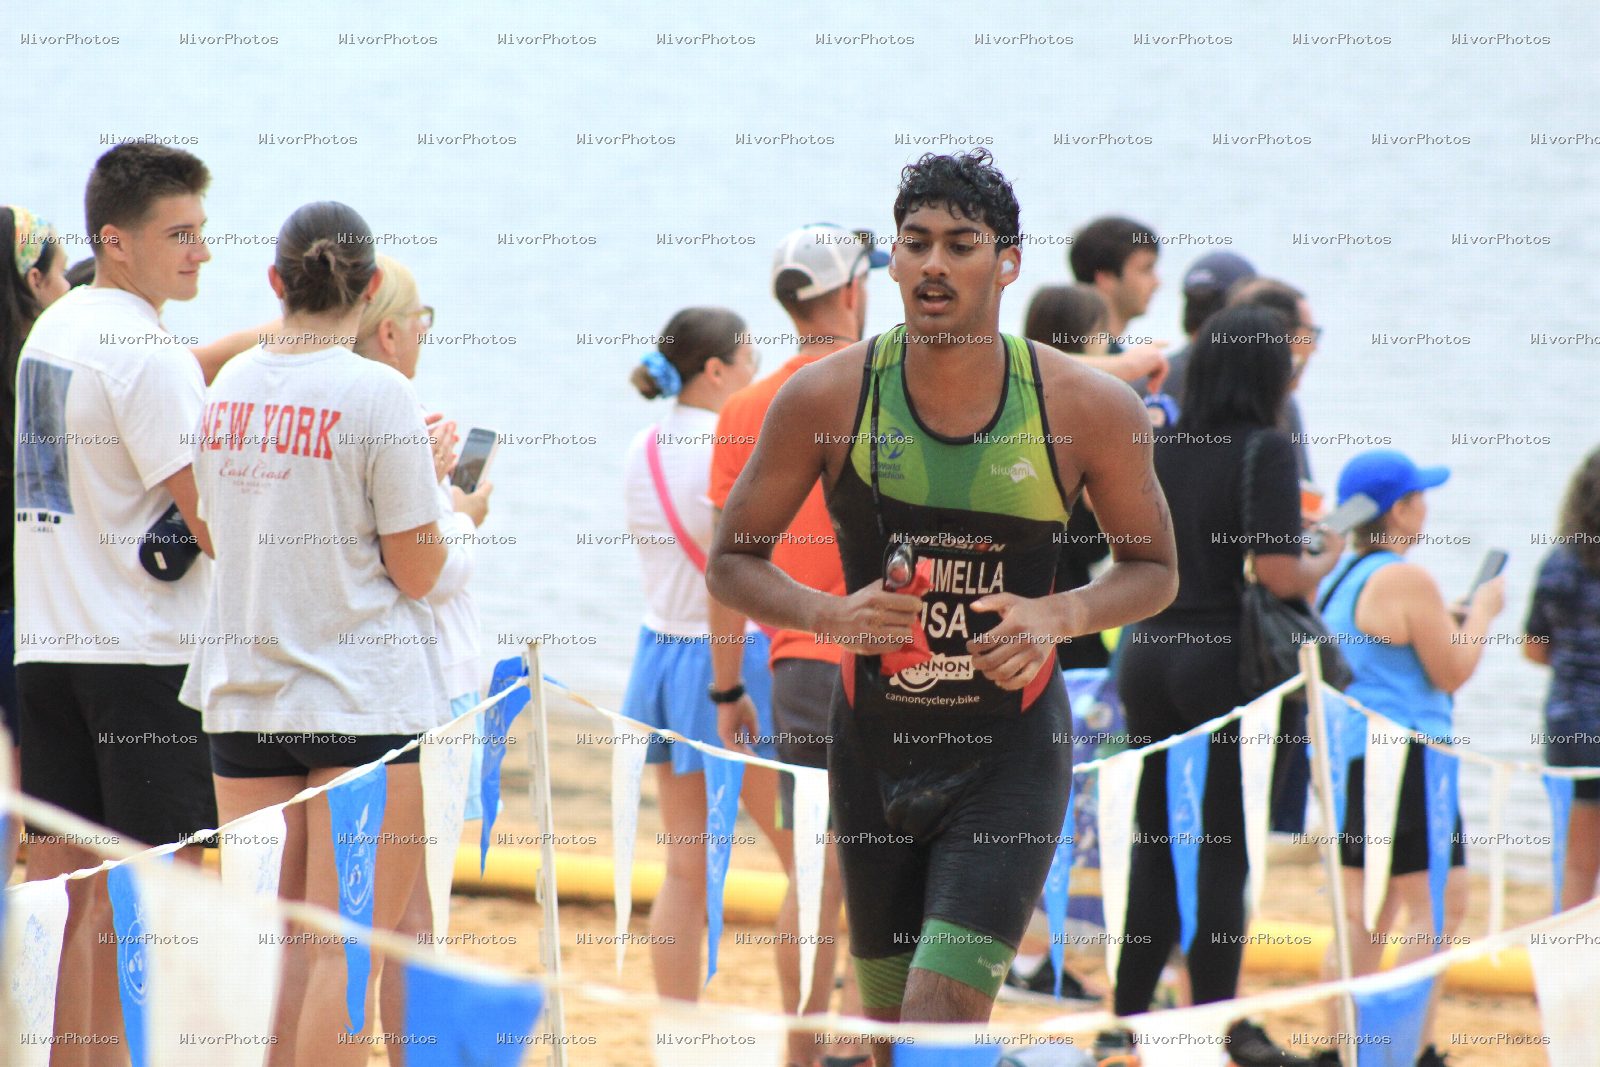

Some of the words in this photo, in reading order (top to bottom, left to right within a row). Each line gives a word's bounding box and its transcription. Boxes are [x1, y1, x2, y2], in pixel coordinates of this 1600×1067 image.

[200, 401, 255, 453] NEW
[260, 404, 342, 461] YORK
[917, 555, 1004, 595] IMELLA
[885, 692, 981, 706] cannoncyclery.bike
